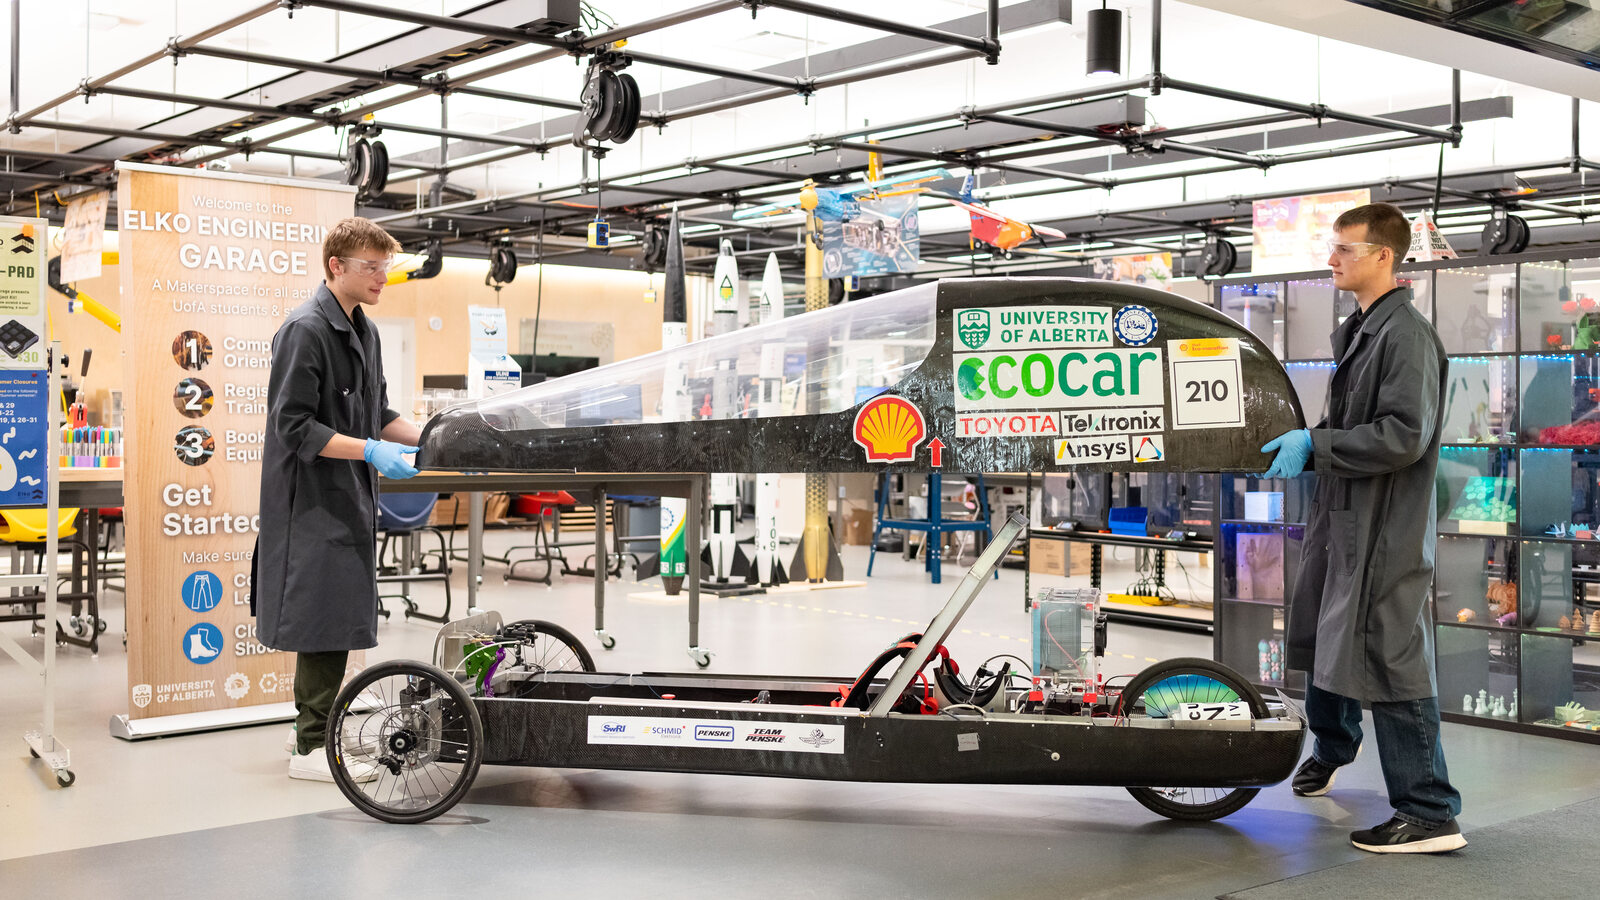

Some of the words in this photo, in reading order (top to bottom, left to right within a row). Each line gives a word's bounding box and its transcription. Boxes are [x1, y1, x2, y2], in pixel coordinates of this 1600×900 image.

[192, 195, 252, 211] Welcome
[256, 202, 269, 213] to
[272, 203, 293, 215] the
[123, 209, 191, 234] ELKO
[198, 215, 329, 244] ENGINEERIN
[180, 243, 307, 275] GARAGE
[152, 279, 163, 291] A
[167, 280, 249, 297] Makerspace
[253, 284, 270, 296] for
[275, 286, 288, 298] all
[173, 300, 206, 313] UofA
[211, 303, 268, 316] students
[271, 305, 280, 317] &
[1000, 311, 1109, 325] UNIVERSITY
[1001, 329, 1023, 343] OF
[1029, 328, 1109, 343] ALBERTA
[17, 351, 39, 363] $30
[186, 338, 197, 364] 1
[957, 351, 1158, 401] ecocar
[185, 385, 203, 411] 2
[1185, 379, 1228, 403] 210
[959, 415, 1057, 435] TOYOTA
[1064, 410, 1161, 433] Tektronix
[185, 433, 204, 458] 3
[225, 430, 266, 445] Book
[1056, 441, 1126, 461] Ansys
[162, 483, 212, 508] Get
[183, 551, 220, 564] Make
[223, 551, 253, 562] sure
[156, 679, 216, 694] UNIVERSITY
[156, 694, 169, 703] OF
[173, 689, 216, 702] ALBERTA
[603, 724, 626, 733] SwRI
[652, 727, 682, 735] SCHMID
